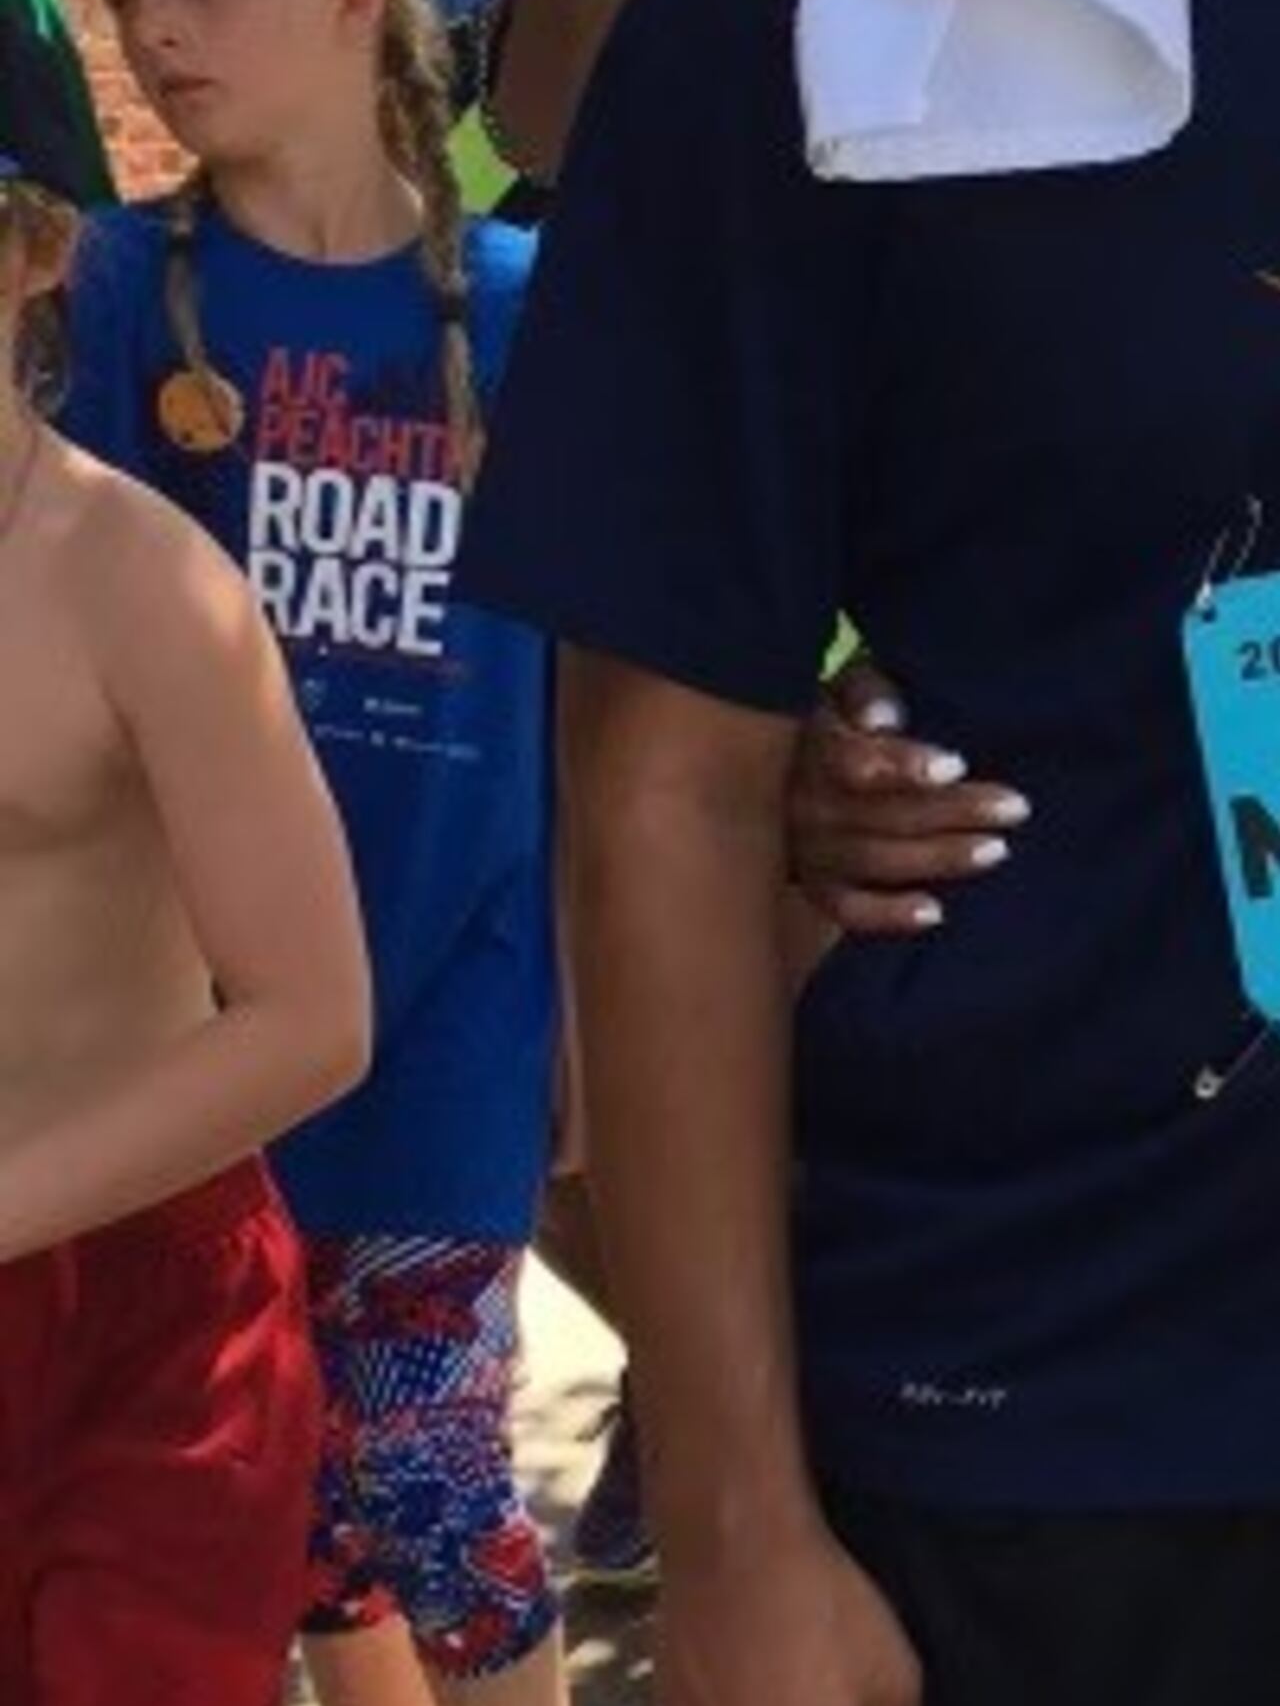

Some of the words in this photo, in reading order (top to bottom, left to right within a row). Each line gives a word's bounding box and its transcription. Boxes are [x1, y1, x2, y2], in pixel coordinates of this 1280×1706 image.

[262, 348, 349, 404] AJC
[251, 461, 460, 568] ROAD
[251, 551, 448, 656] RACE
